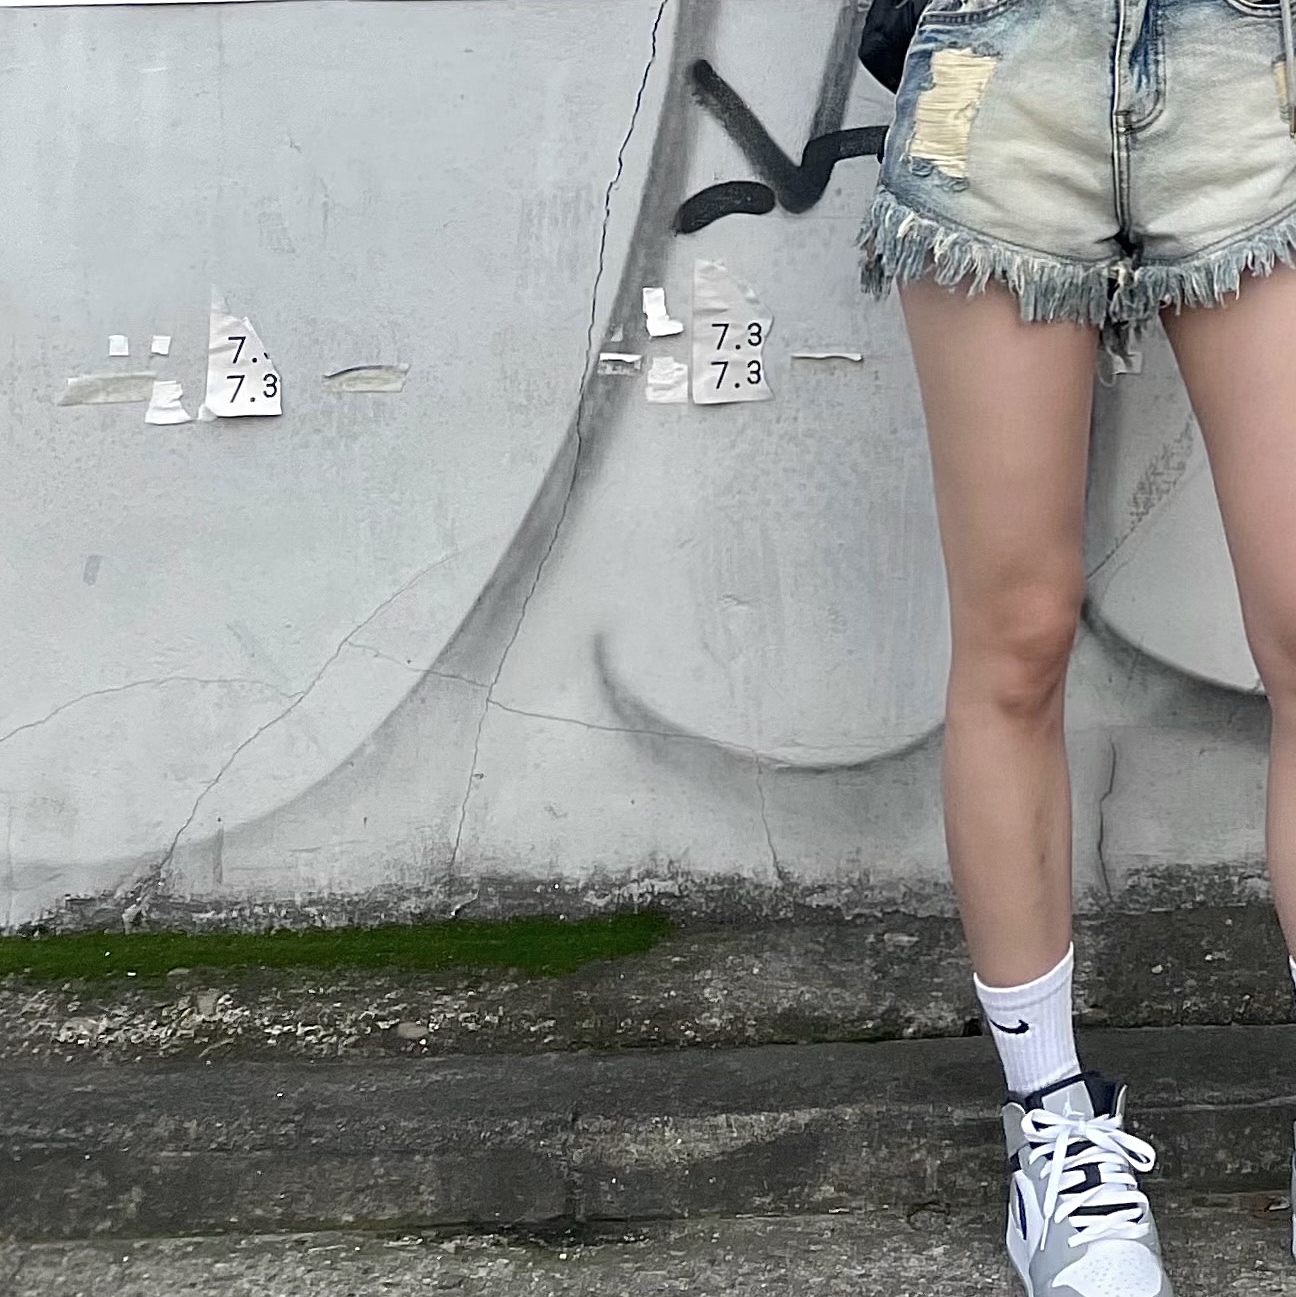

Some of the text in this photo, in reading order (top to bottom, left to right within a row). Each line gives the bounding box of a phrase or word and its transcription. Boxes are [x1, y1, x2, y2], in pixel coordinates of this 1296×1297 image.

[228, 336, 269, 364] 7.
[711, 322, 763, 350] 7.3
[227, 373, 278, 403] 7.3
[711, 359, 762, 389] 7.3
